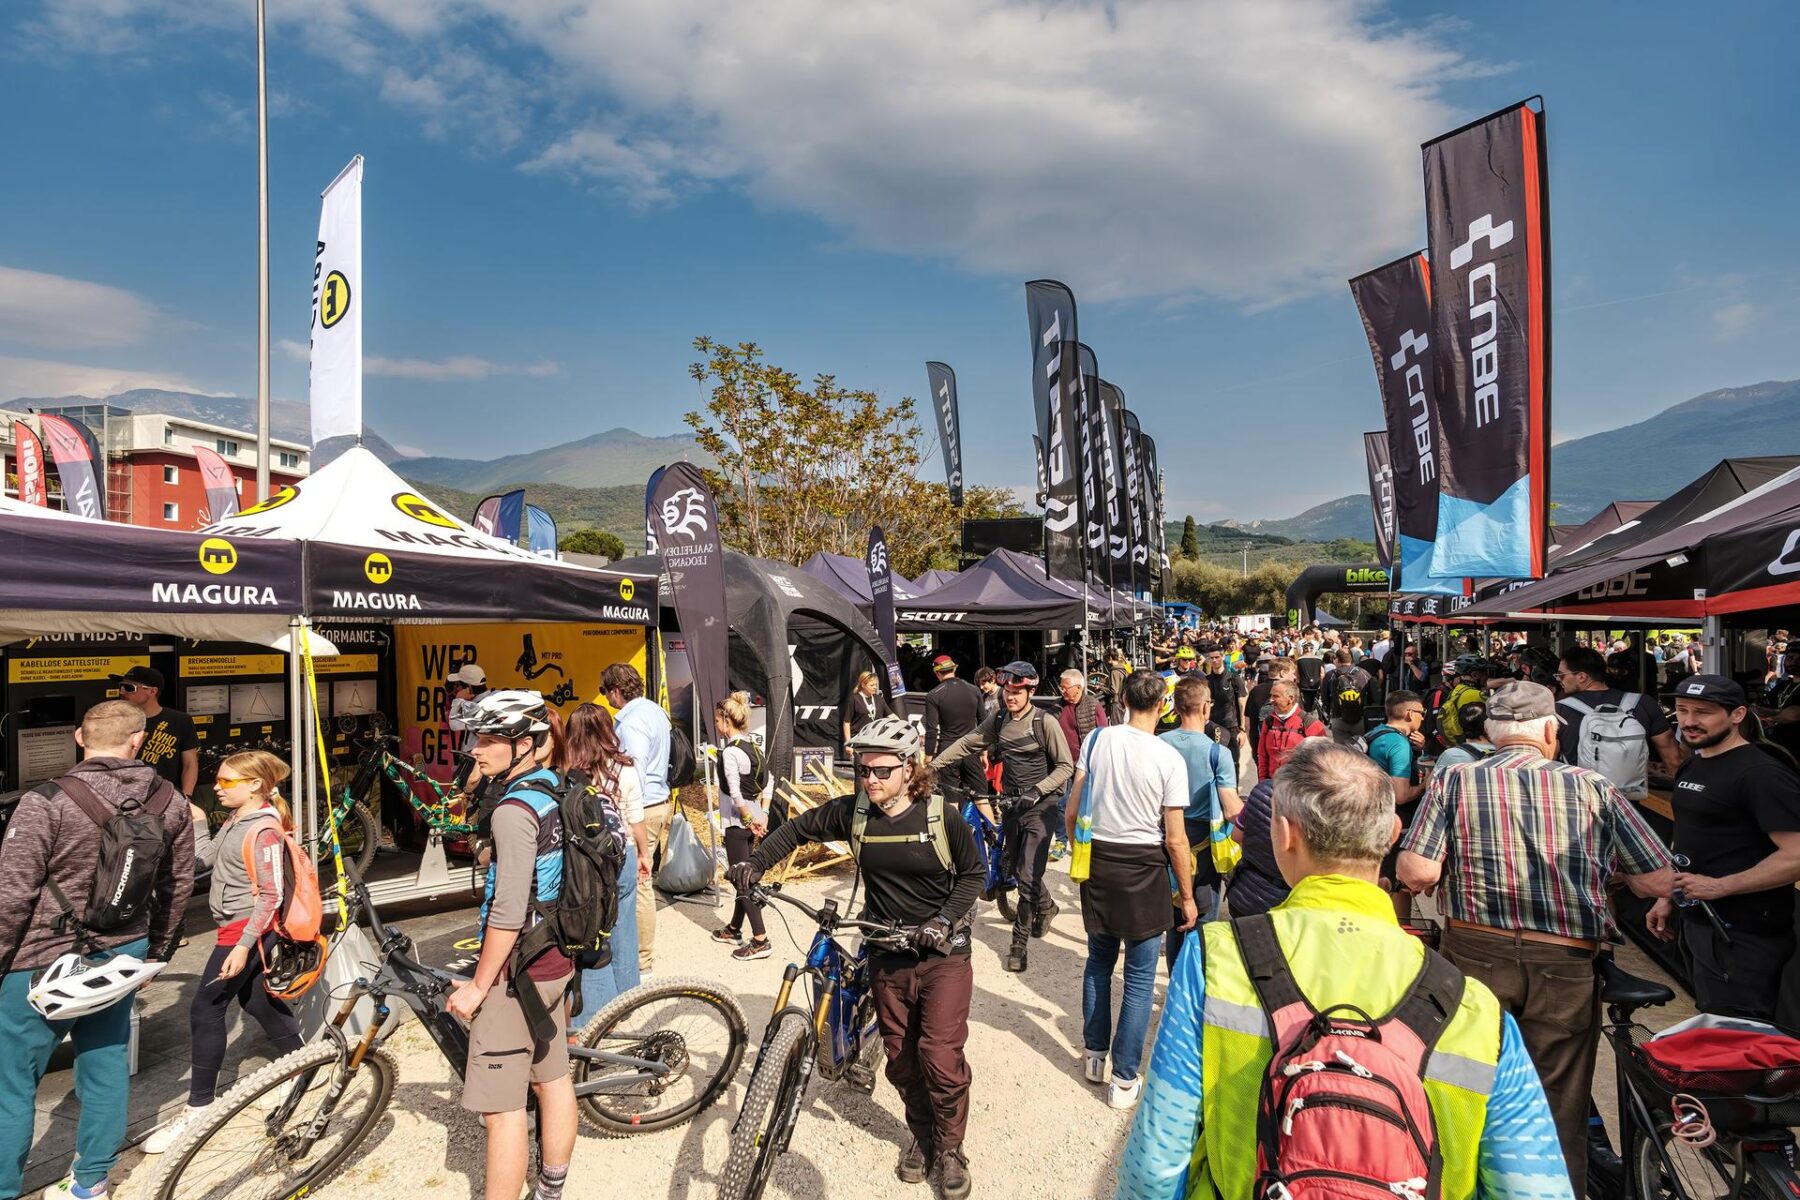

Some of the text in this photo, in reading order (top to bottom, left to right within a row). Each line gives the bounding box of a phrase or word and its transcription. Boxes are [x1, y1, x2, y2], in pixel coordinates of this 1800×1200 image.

[1346, 568, 1387, 582] bike
[152, 582, 278, 606] MAGURA
[333, 590, 421, 611] MAGURA
[603, 605, 650, 620] MAGURA
[900, 611, 968, 621] SCOTT
[20, 658, 111, 668] KABELLOSE SATTELSTÜTZE
[152, 730, 177, 747] WHO
[141, 750, 160, 764] YOU
[145, 740, 177, 759] STOPS
[1678, 781, 1706, 792] CUBE
[111, 848, 135, 907] ROCKRIDER
